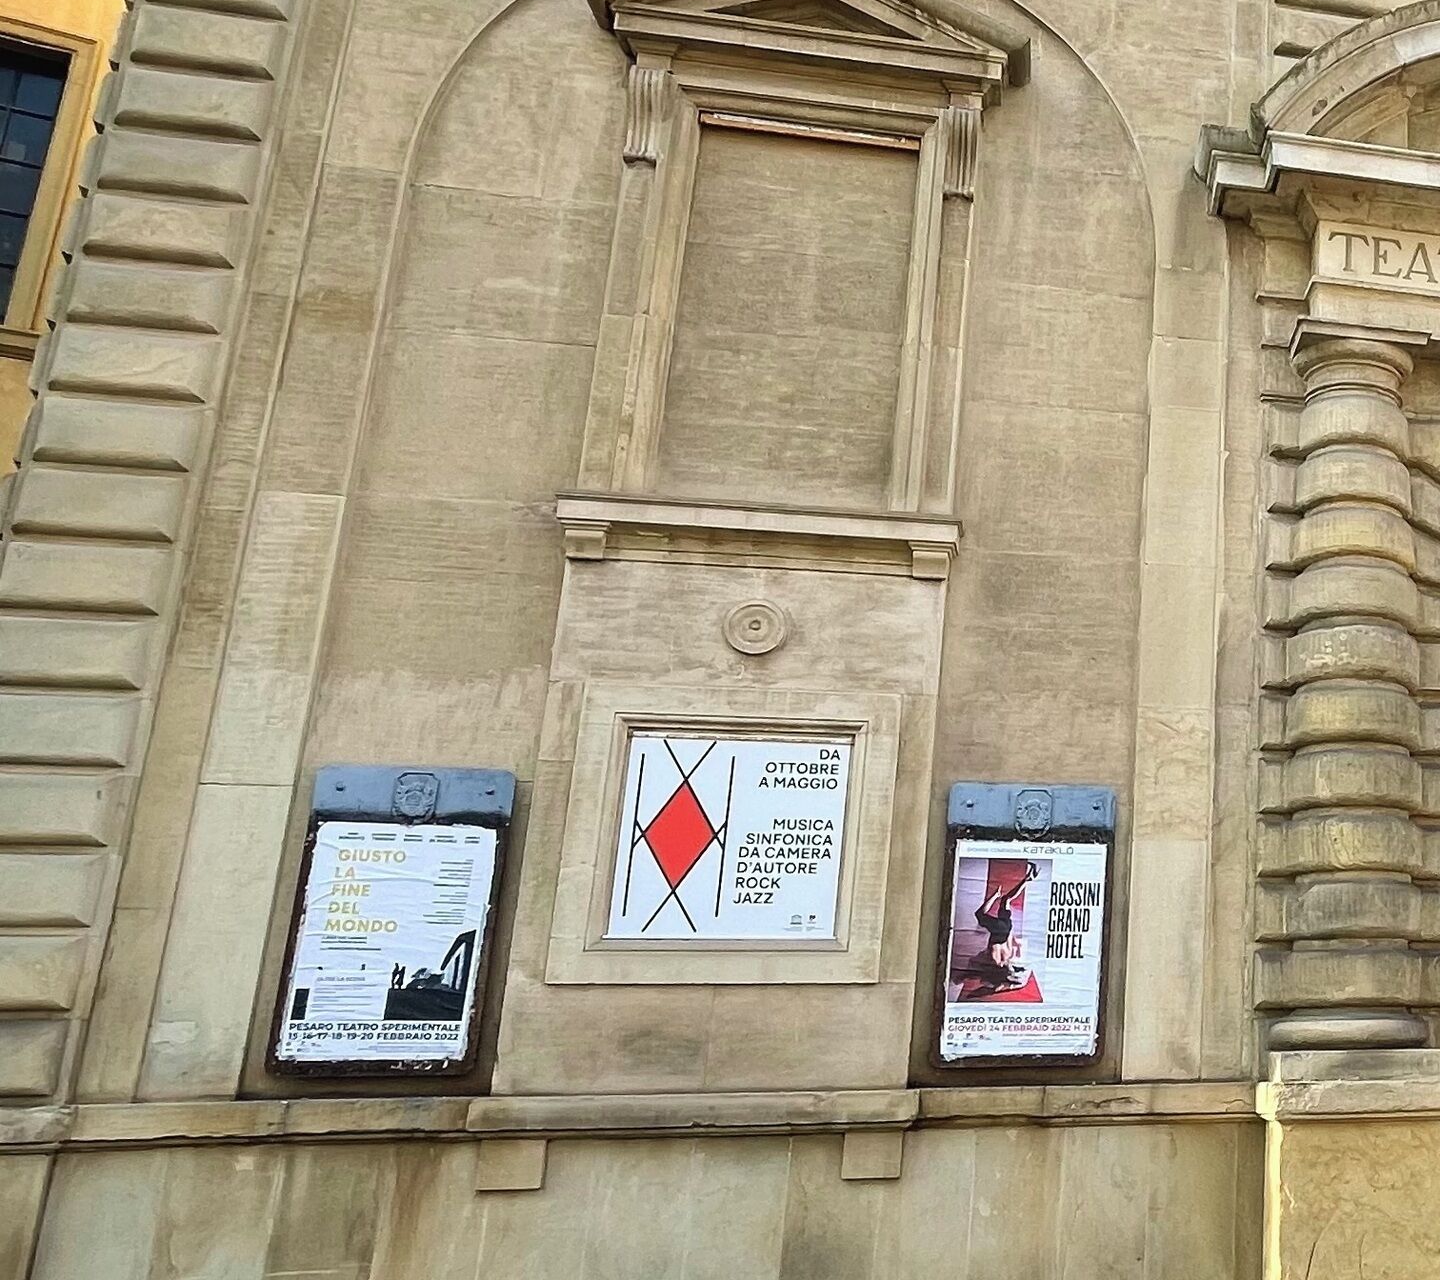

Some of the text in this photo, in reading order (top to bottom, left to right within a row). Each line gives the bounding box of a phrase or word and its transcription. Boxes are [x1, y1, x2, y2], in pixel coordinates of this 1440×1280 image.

[820, 749, 840, 760] DA
[765, 762, 840, 775] OTTOBRE
[759, 776, 838, 789] A MAGGIO
[773, 819, 834, 831] MUSICA
[745, 833, 833, 846] SINFONICA
[338, 849, 406, 863] GIUSTO
[738, 846, 831, 859] DA CAMERA
[334, 866, 355, 879] LA
[736, 861, 818, 874] D'AUTORE
[735, 877, 781, 889] ROCK
[331, 884, 371, 897] FINE
[1049, 882, 1101, 906] ROSSINI
[733, 892, 774, 904] JAZZ
[327, 901, 360, 915] DEL
[324, 919, 398, 933] MONDO
[1048, 908, 1090, 933] GRAND
[1045, 933, 1084, 959] HOTEL
[288, 1022, 461, 1031] PESARO TEATRO SPERIMENTALE
[948, 1016, 985, 1024] PESARO
